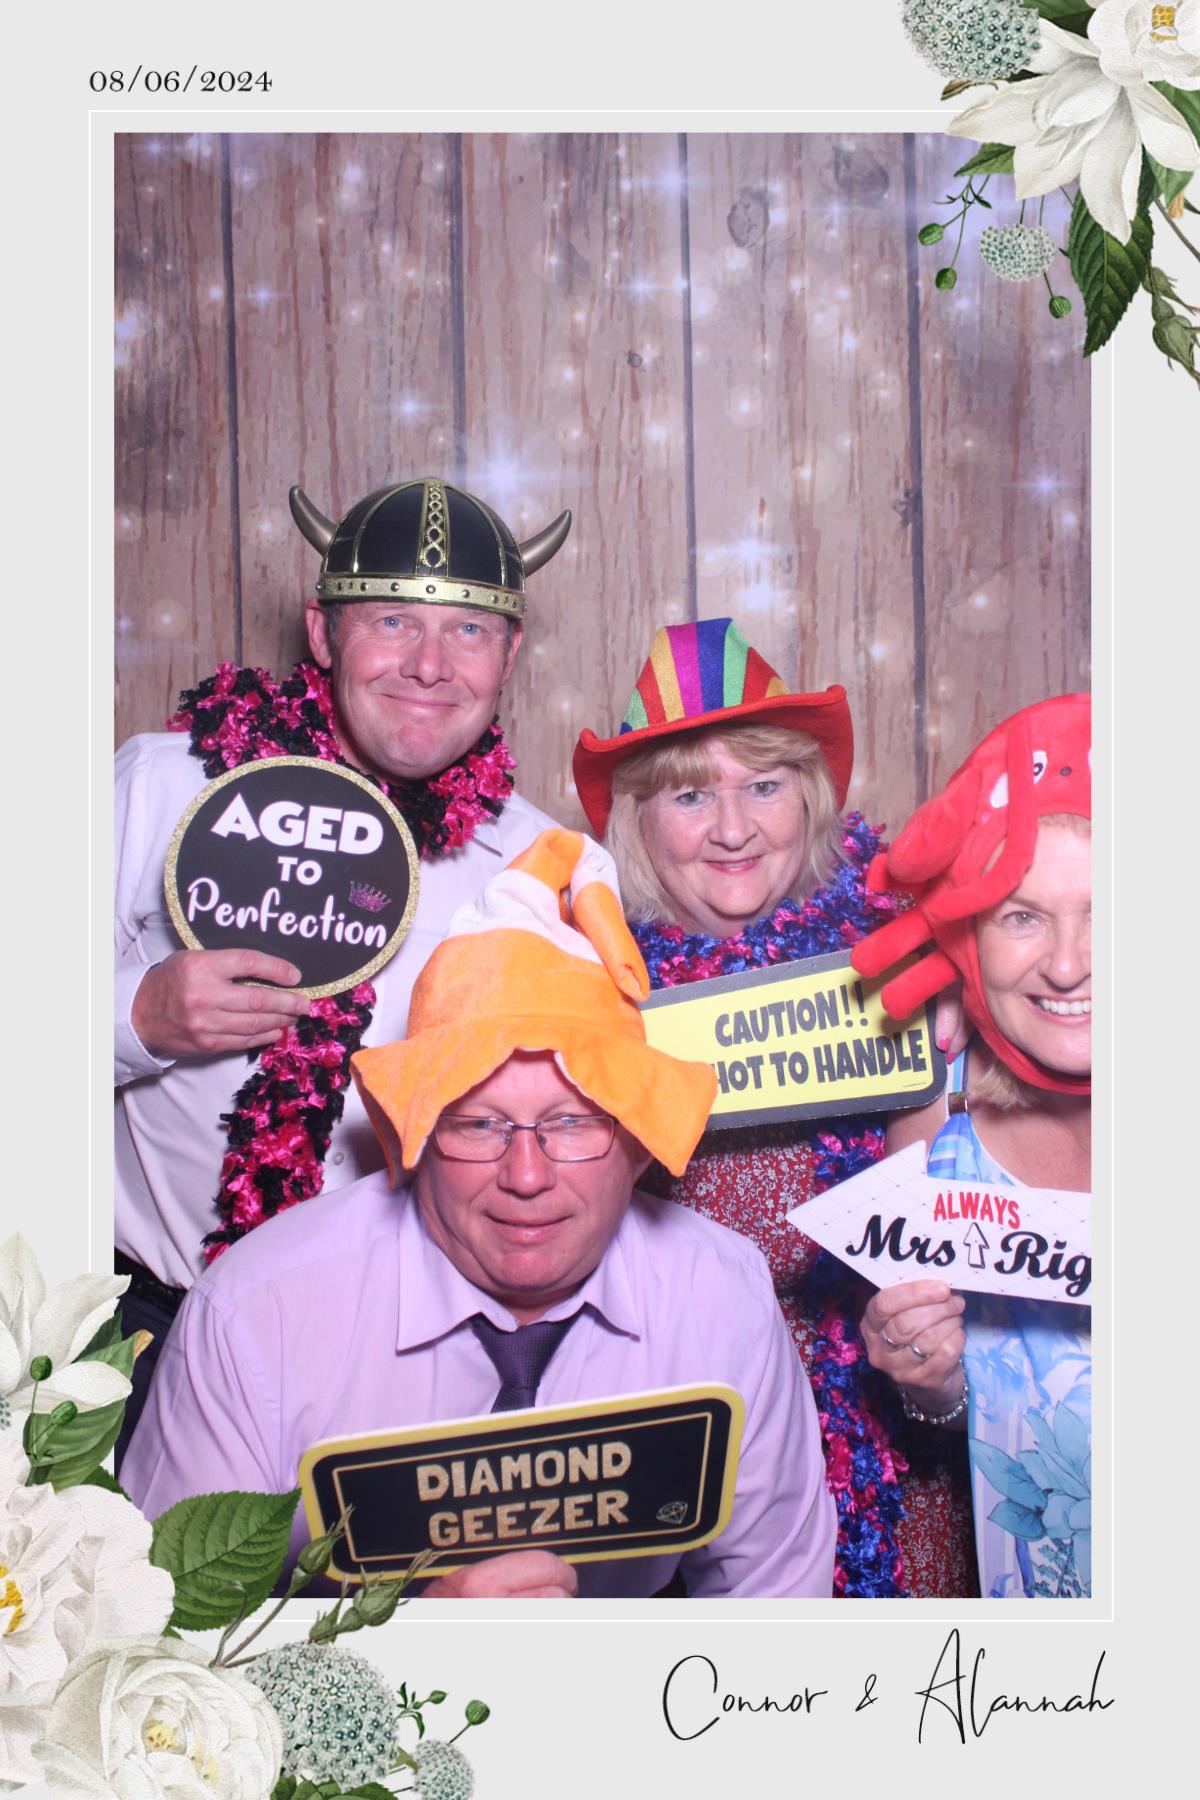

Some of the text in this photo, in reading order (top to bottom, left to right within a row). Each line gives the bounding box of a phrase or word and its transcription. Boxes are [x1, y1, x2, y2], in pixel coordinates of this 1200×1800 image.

[210, 792, 384, 855] AGED
[276, 856, 323, 886] TO
[187, 877, 387, 948] Perfection
[714, 980, 869, 1047] CAUTION!!
[769, 1050, 810, 1088] TO
[813, 1029, 927, 1084] HANDLE
[933, 1191, 1021, 1230] ALWAYS
[845, 1214, 956, 1267] Mrs
[416, 1441, 633, 1502] DIAMOND
[428, 1489, 630, 1547] GEEZER
